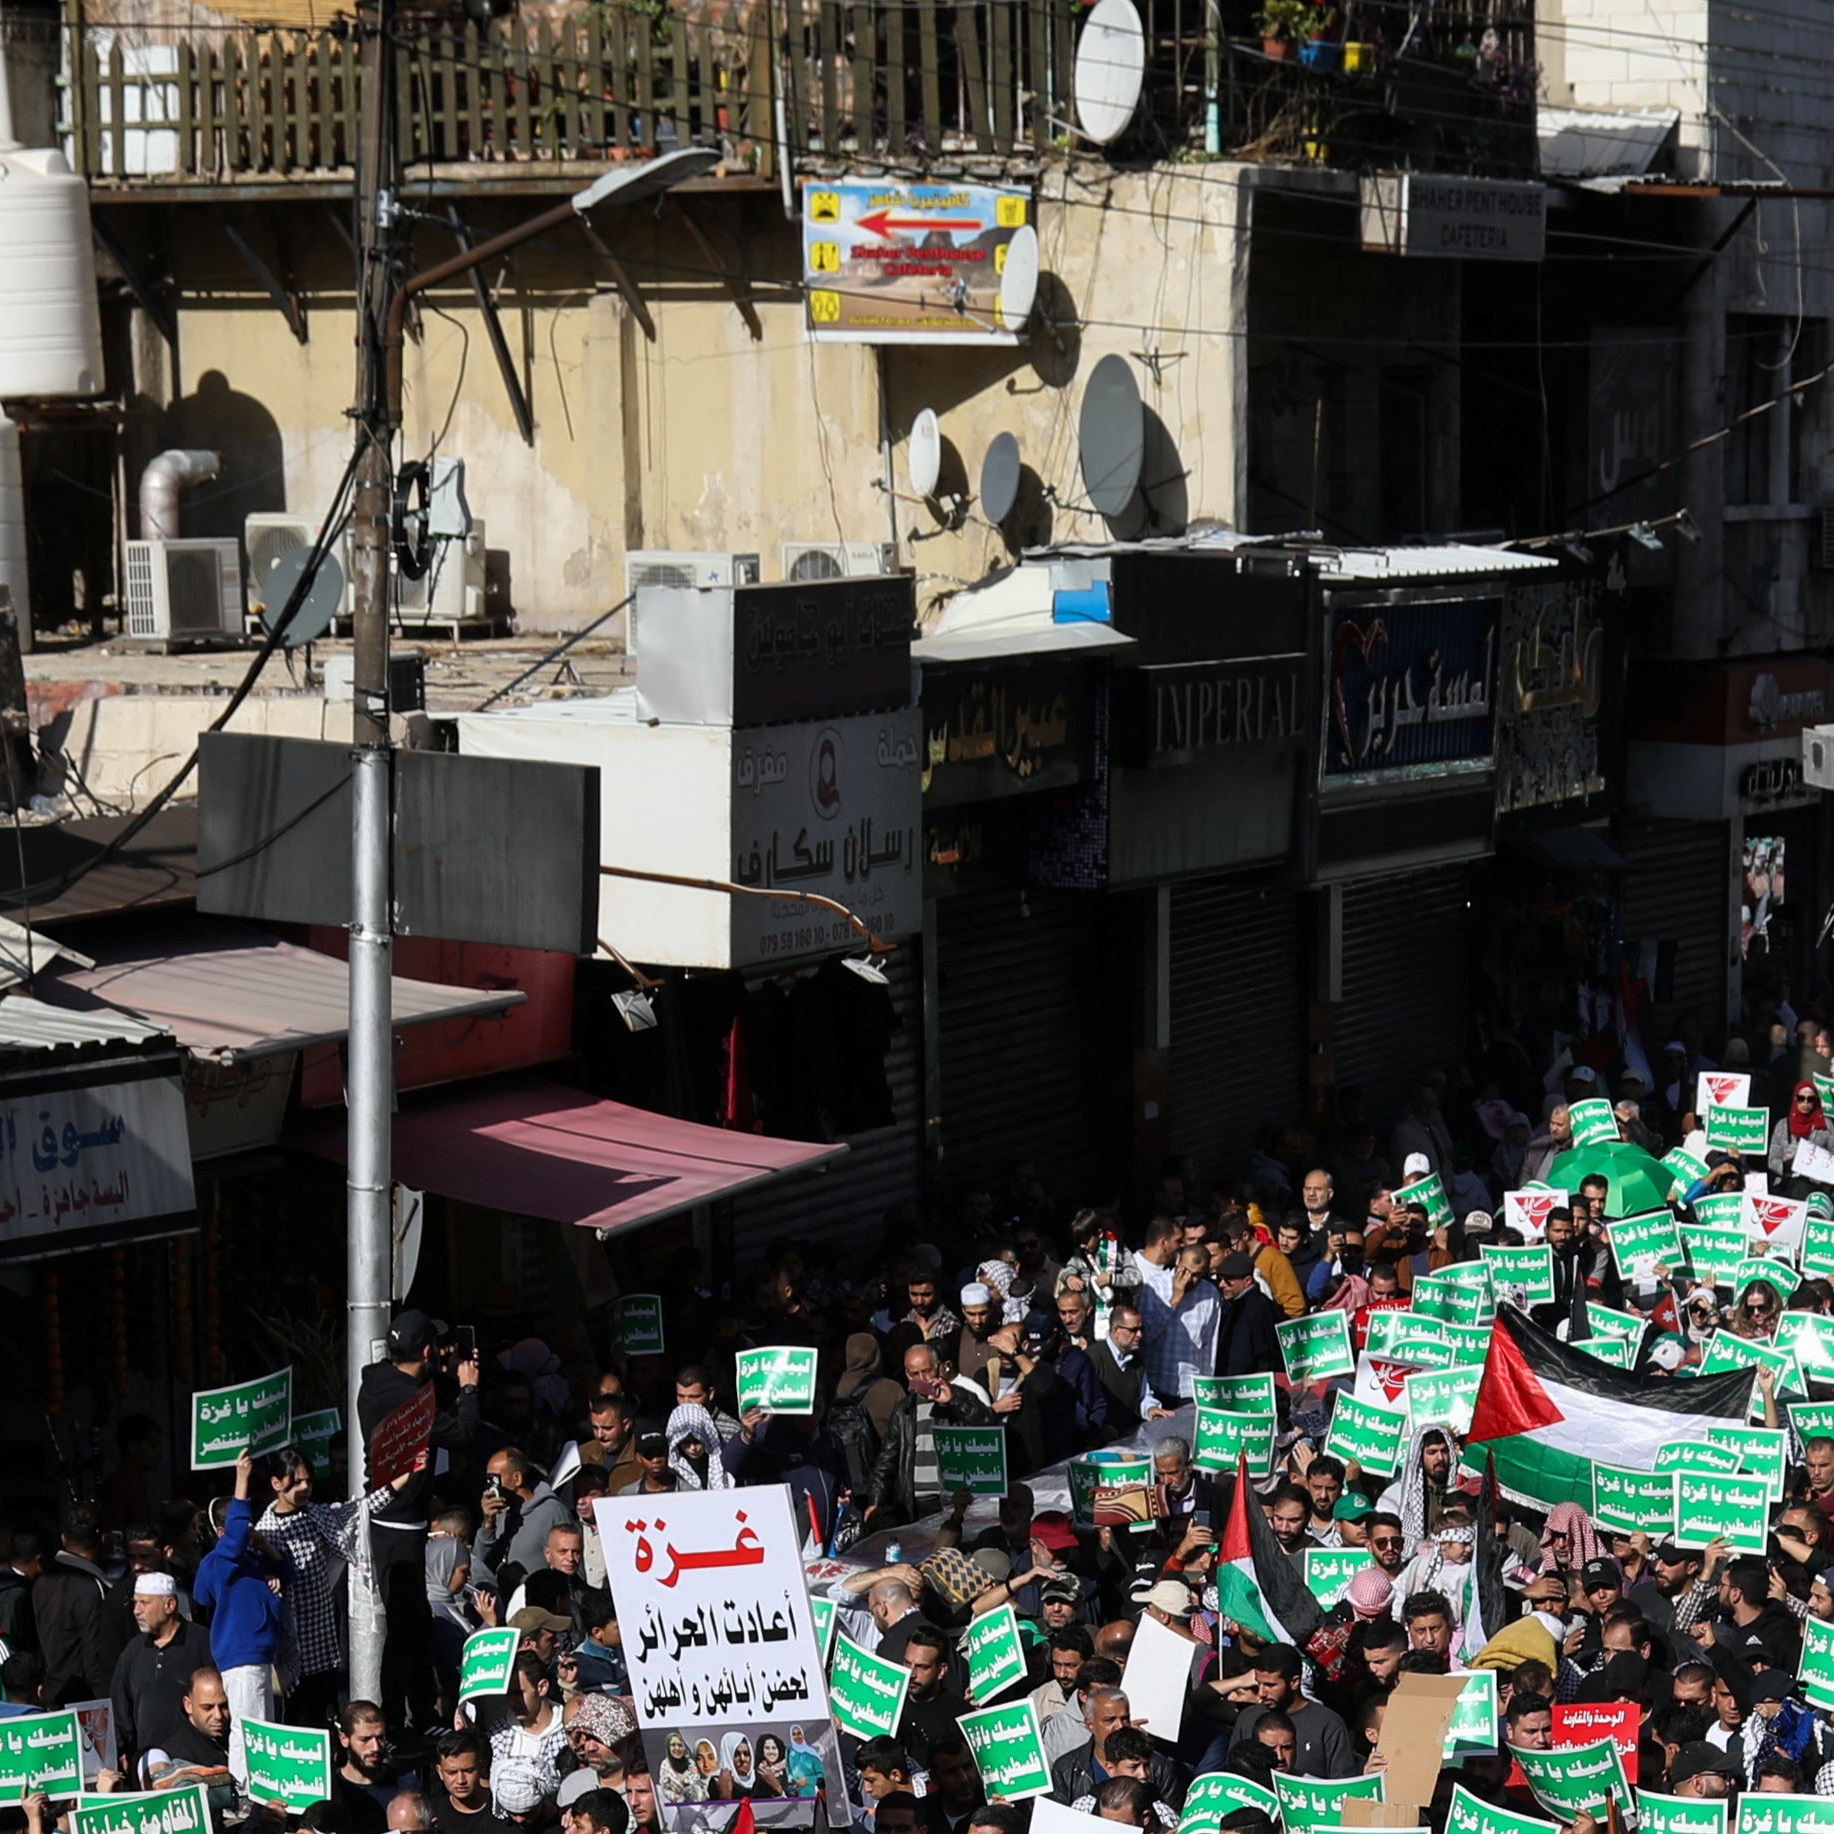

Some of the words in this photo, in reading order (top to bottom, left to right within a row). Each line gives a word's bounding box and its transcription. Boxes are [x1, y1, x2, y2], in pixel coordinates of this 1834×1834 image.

[1410, 184, 1465, 211] SHAHER
[1466, 186, 1543, 218] PENTHOUSE
[905, 246, 986, 261] Penthouse
[1440, 223, 1509, 250] CAFETERIA
[884, 262, 953, 277] Cafeteria
[826, 589, 856, 664] أبو
[1428, 622, 1496, 721] لمسة
[1155, 673, 1304, 752] IMPERIAL
[1363, 646, 1429, 757] حرير
[877, 724, 918, 770] جملة
[920, 680, 1007, 793] القدس
[1005, 692, 1066, 778] عبير
[736, 744, 789, 798] مفرق
[736, 828, 834, 888] سكارف
[843, 816, 914, 883] رسلان
[32, 1110, 126, 1172] سوق
[43, 1179, 90, 1226] جاهزة
[200, 1396, 232, 1424] غزة
[236, 1395, 248, 1419] يا
[252, 1381, 287, 1410] لبيك
[199, 1429, 251, 1456] ستنتصر
[251, 1415, 286, 1446] فلسطين
[1681, 1479, 1708, 1504] غزة
[1710, 1483, 1723, 1508] يا
[1725, 1483, 1764, 1510] لبيك
[1681, 1514, 1722, 1533] ستنتصر
[1722, 1517, 1762, 1539] فلسطين
[625, 1509, 765, 1588] غزة
[634, 1601, 719, 1663] الحرائر
[723, 1589, 798, 1645] أعادت
[643, 1666, 687, 1719] أهلهن
[691, 1681, 702, 1716] و
[704, 1663, 756, 1718] أبائهن
[761, 1665, 809, 1713] لحضن
